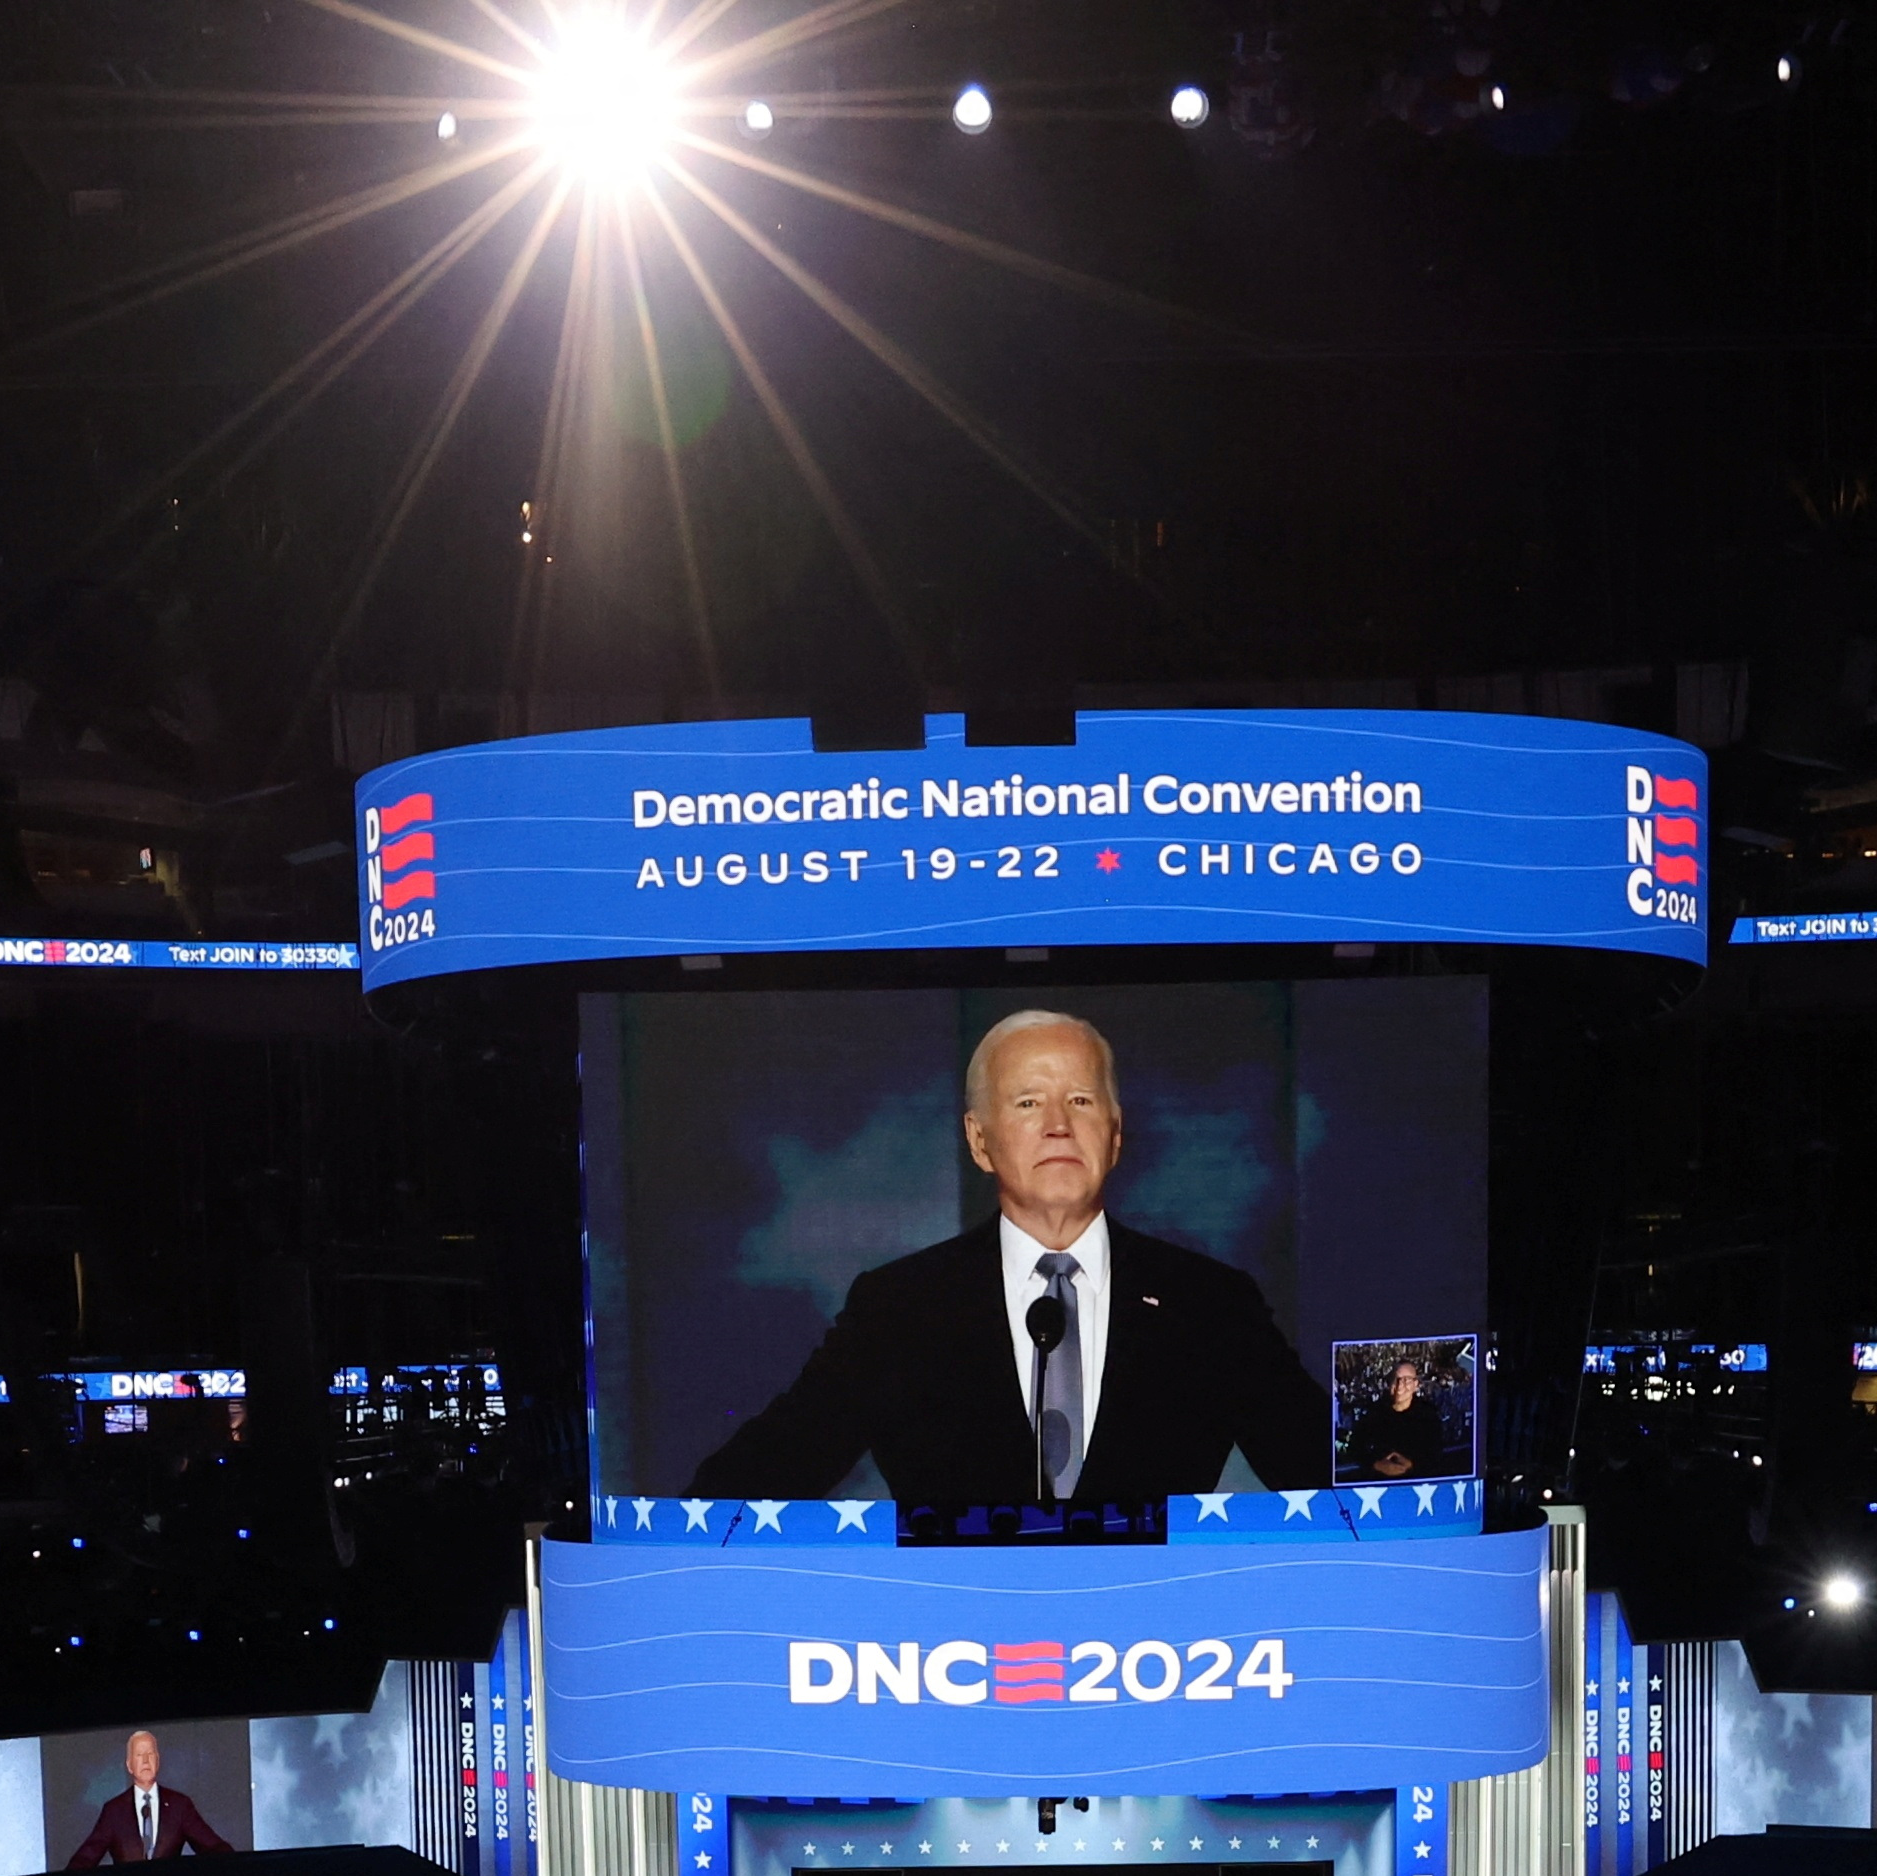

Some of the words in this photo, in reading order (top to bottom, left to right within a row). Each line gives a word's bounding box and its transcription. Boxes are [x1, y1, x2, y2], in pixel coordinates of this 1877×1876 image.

[634, 778, 908, 827] Democratic
[923, 774, 1128, 817] National
[1144, 771, 1420, 814] Convention
[637, 851, 867, 888] AUGUST
[902, 846, 1058, 879] 19-22
[1159, 843, 1421, 875] CHICAGO
